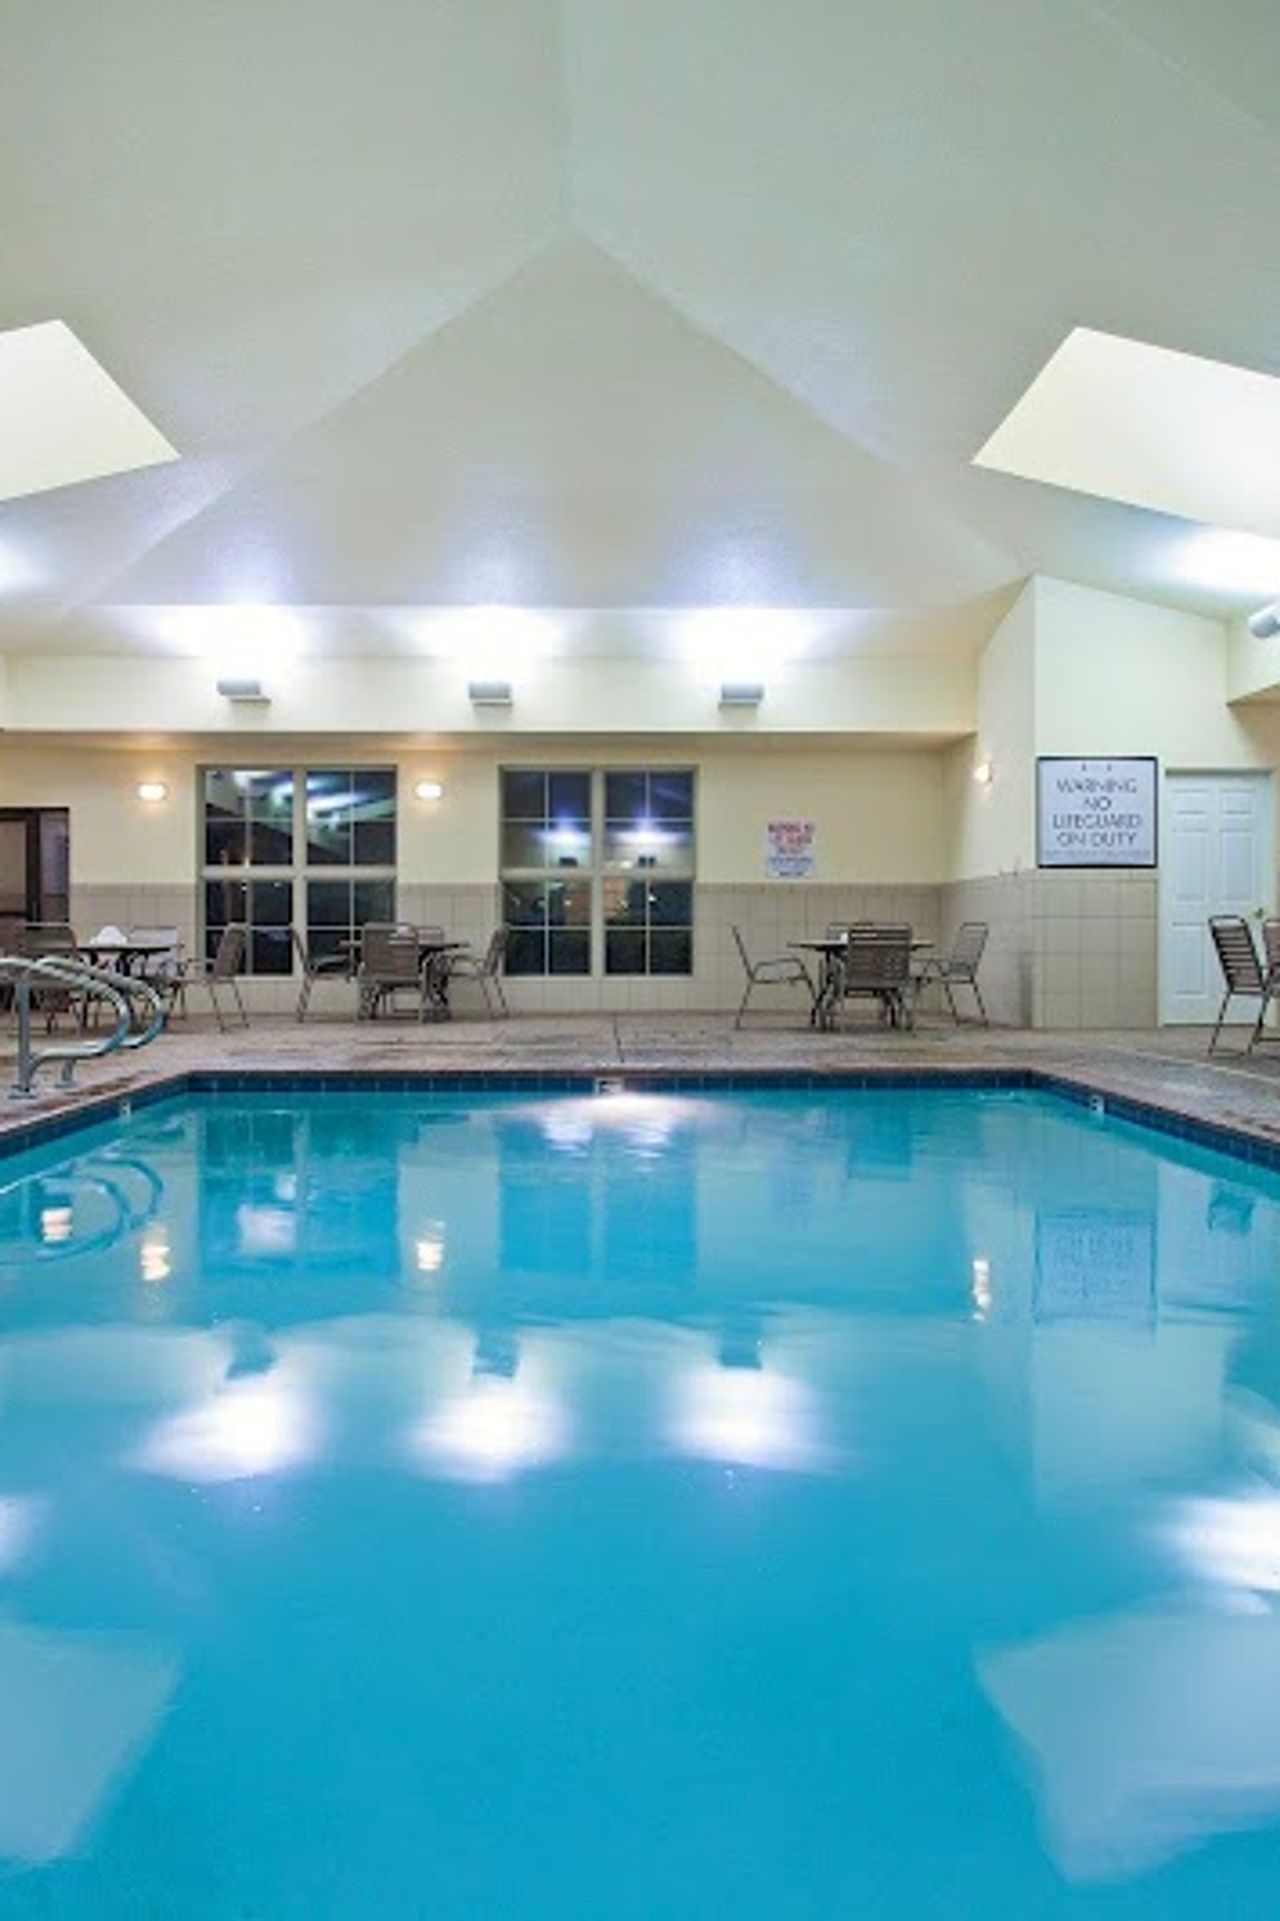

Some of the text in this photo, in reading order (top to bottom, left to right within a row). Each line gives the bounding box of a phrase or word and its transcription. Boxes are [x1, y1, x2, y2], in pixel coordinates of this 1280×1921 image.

[1085, 796, 1112, 811] NO
[1052, 813, 1142, 829] LIFEGUARD
[1056, 831, 1137, 847] ON DUTY
